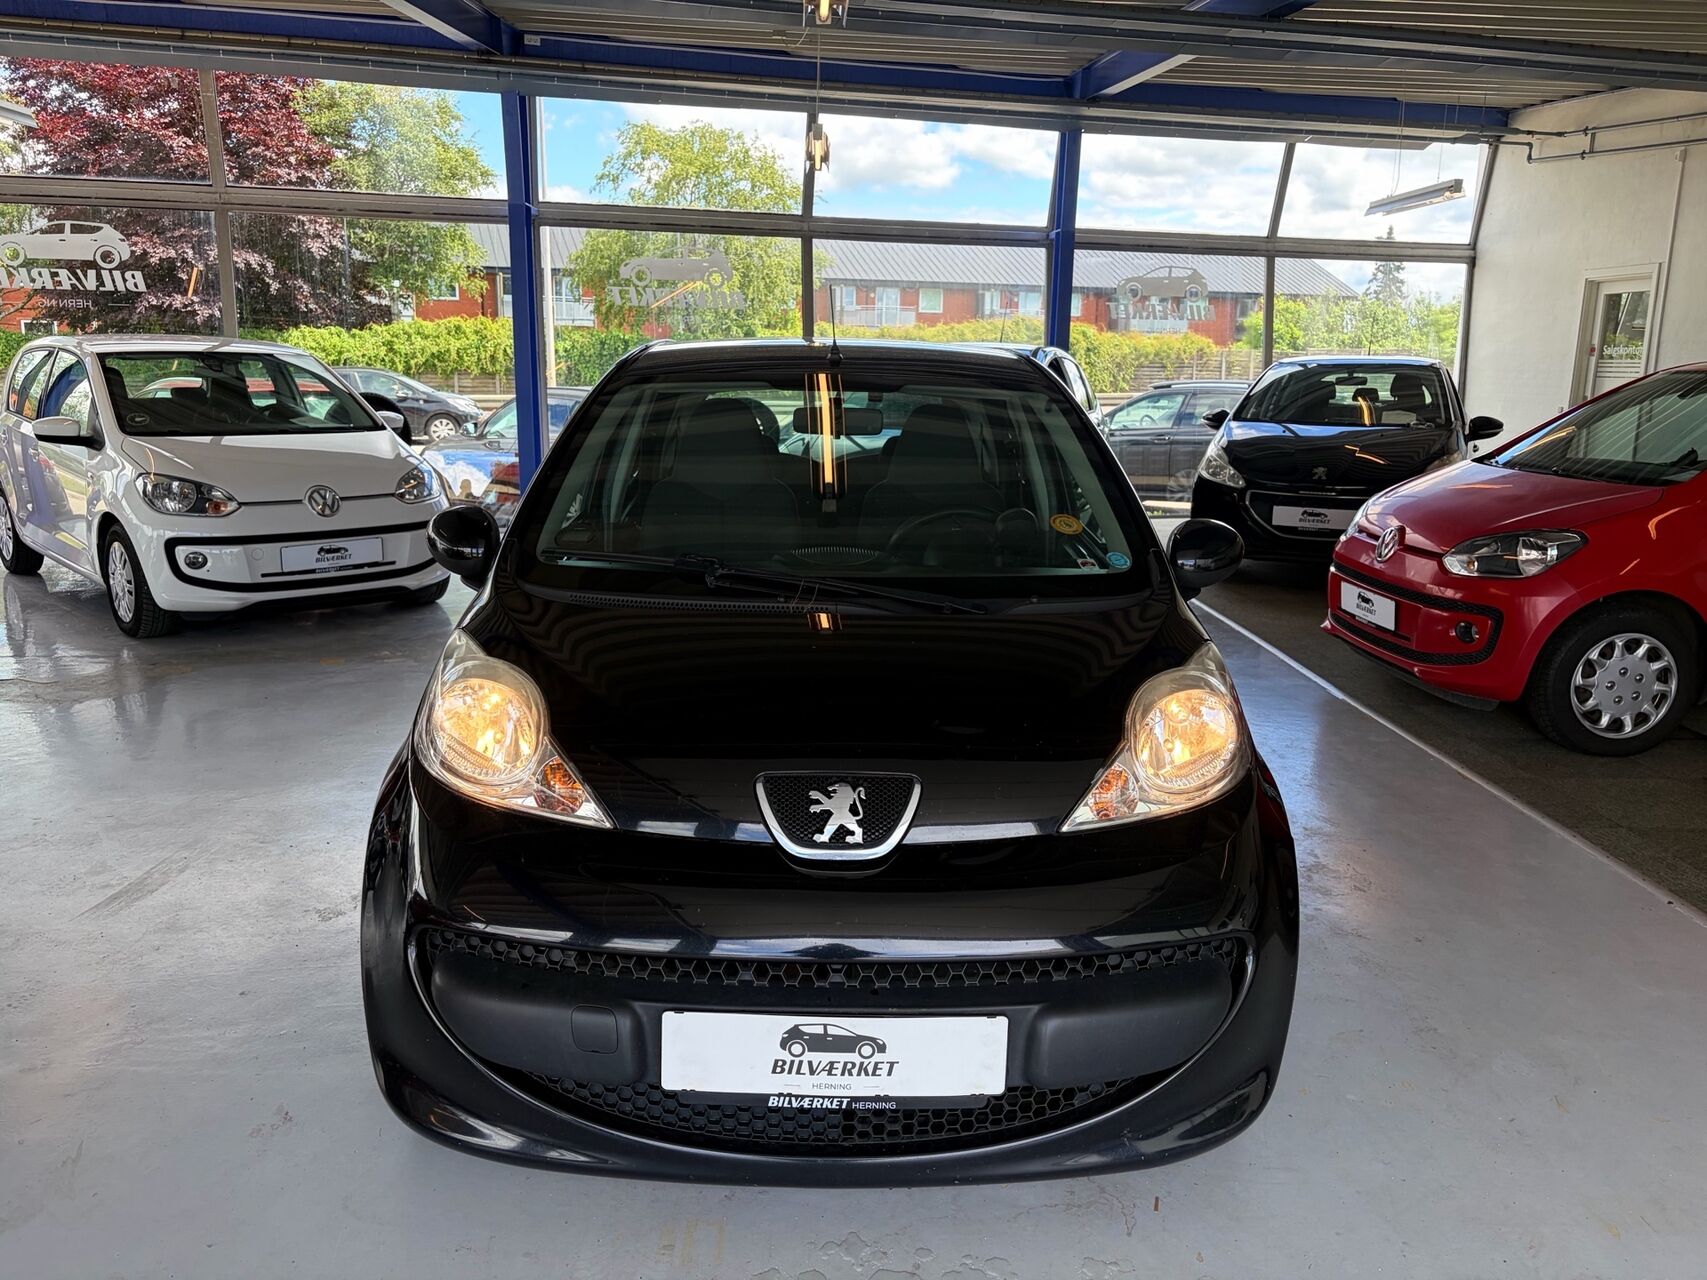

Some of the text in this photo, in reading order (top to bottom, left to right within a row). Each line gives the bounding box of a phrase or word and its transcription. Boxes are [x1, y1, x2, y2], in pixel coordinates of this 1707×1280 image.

[771, 1059, 899, 1077] BILVÆRKET
[812, 1082, 851, 1090] HERNING
[768, 1096, 850, 1109] BILVÆRKET
